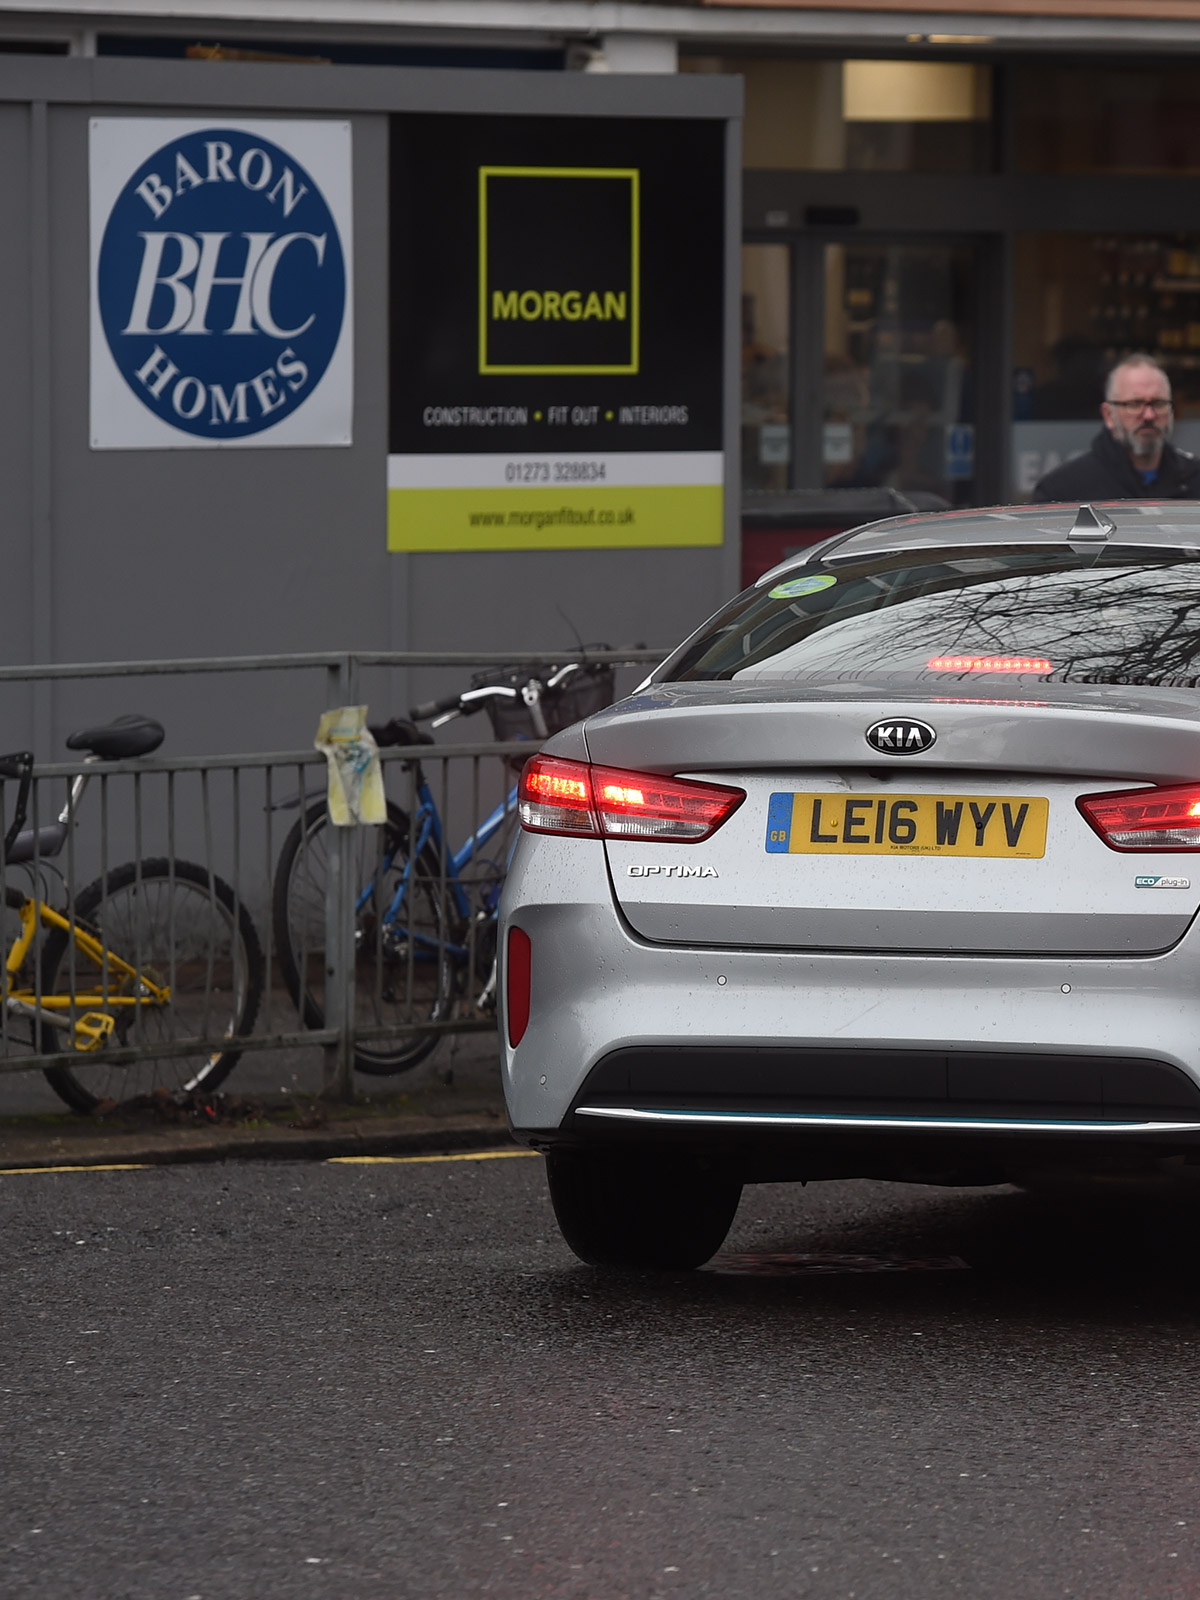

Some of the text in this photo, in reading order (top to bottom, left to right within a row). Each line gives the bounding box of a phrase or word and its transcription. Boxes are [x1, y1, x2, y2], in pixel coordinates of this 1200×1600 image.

[134, 140, 309, 220] BARON
[120, 231, 328, 339] BHC
[492, 291, 626, 320] MORGAN
[134, 345, 309, 425] HOMES
[423, 405, 689, 426] CONSTRUCTION FIT OUT INTERIORS
[505, 462, 549, 482] 01273
[877, 727, 924, 747] KIA
[810, 799, 1030, 847] LE16 WYV
[770, 830, 787, 842] GB
[627, 865, 719, 878] OPTIMA
[1161, 878, 1187, 886] plug-in
